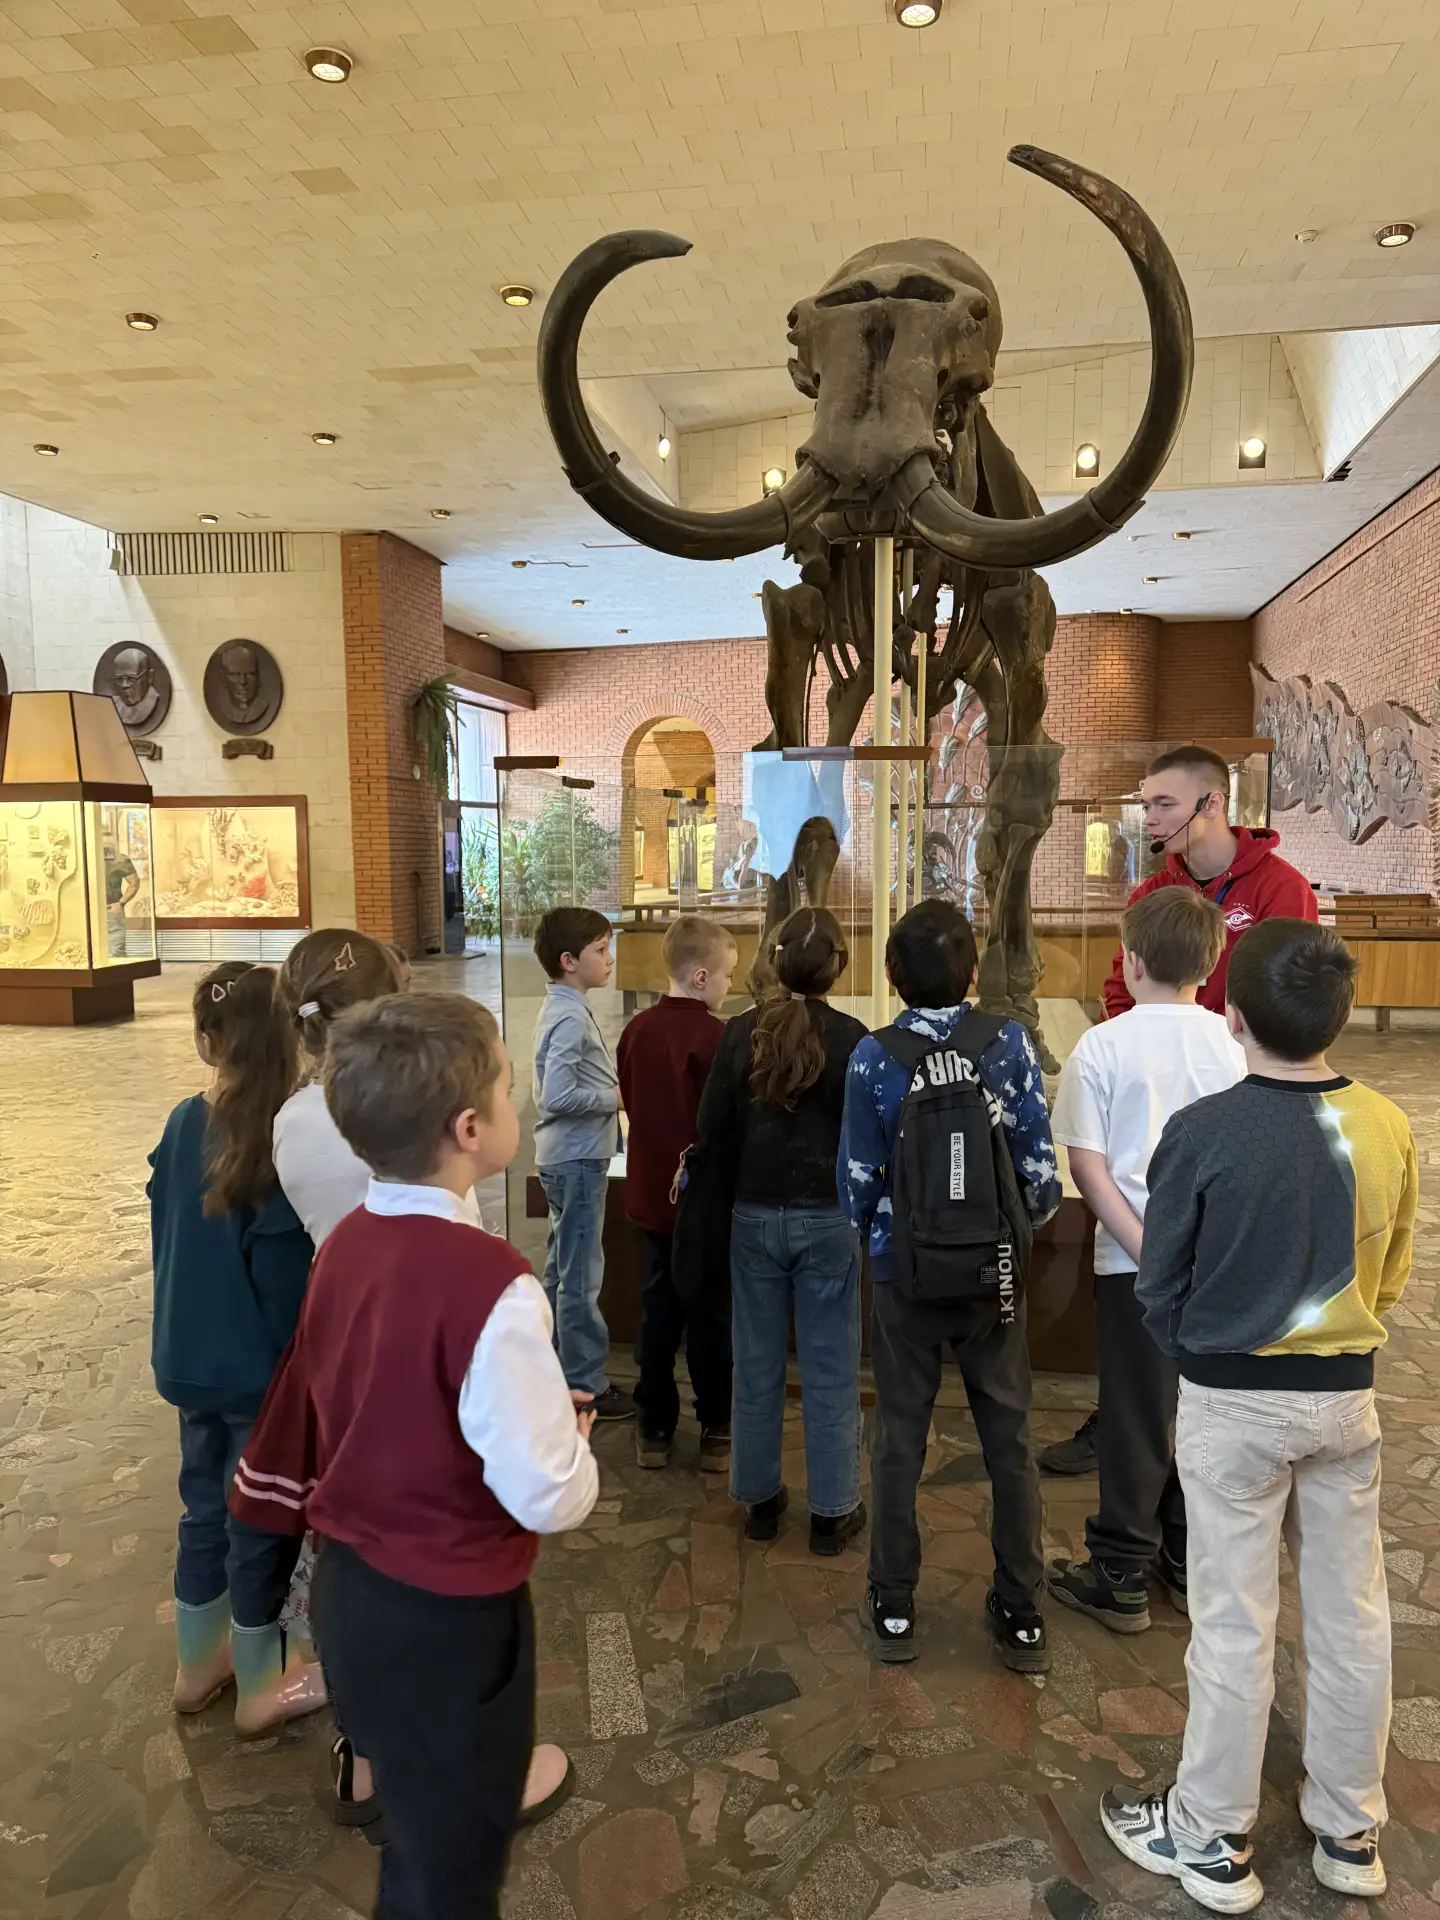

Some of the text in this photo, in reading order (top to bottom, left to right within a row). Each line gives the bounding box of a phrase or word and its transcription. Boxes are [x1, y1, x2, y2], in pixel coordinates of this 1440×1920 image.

[952, 1135, 962, 1197] BE YOUR STYLE
